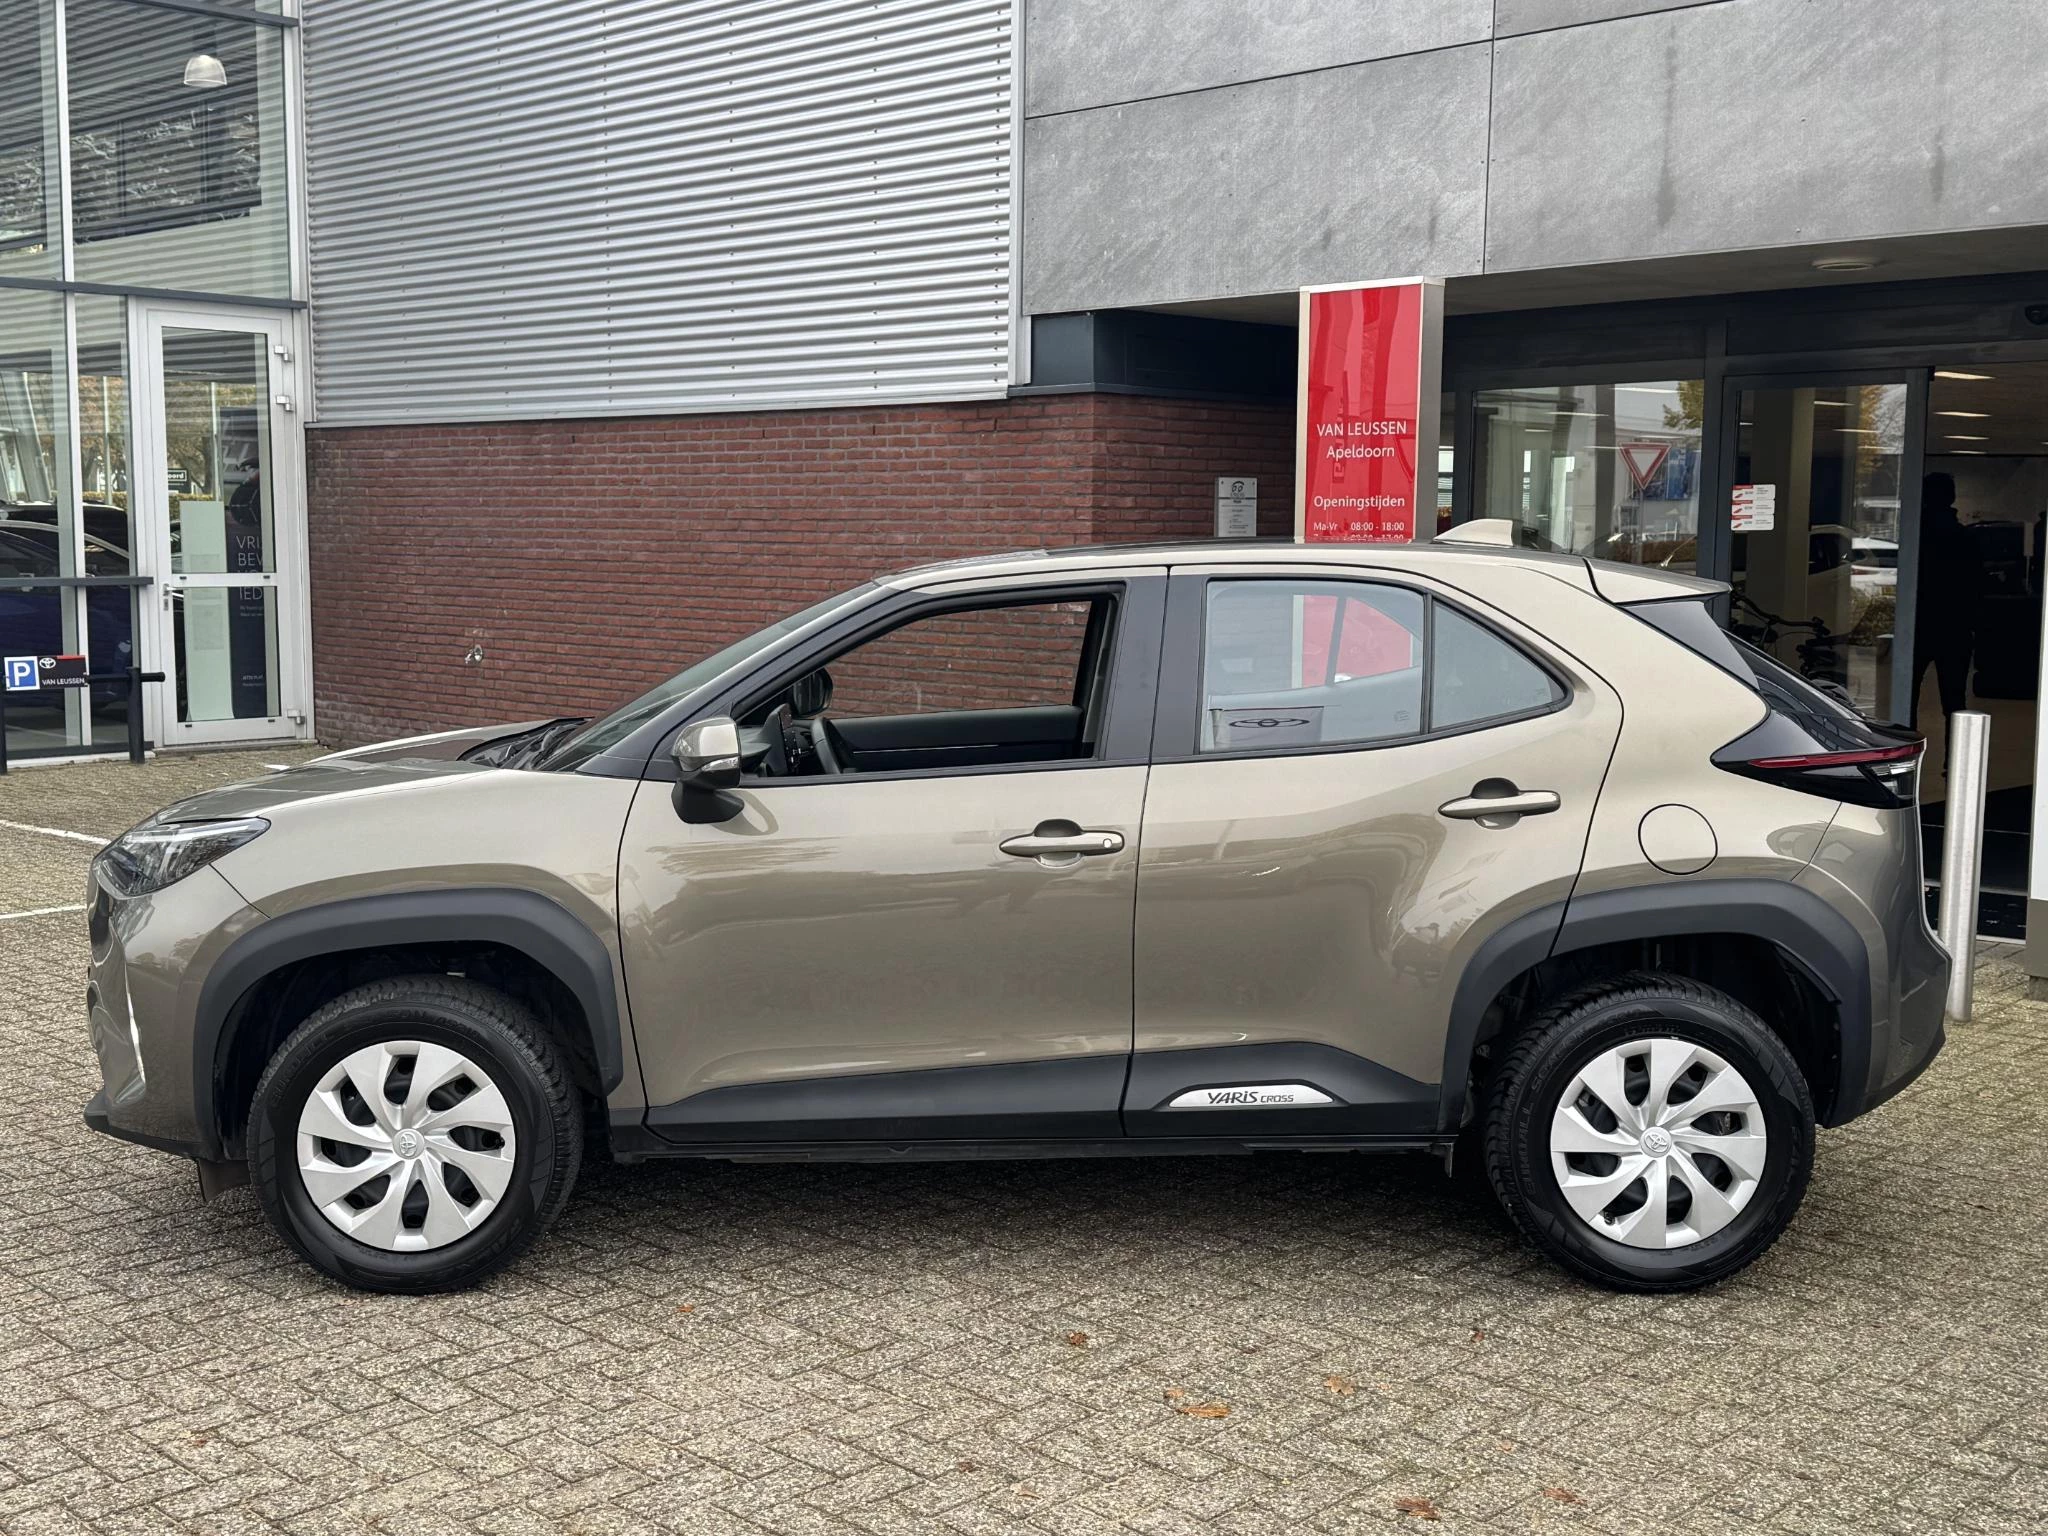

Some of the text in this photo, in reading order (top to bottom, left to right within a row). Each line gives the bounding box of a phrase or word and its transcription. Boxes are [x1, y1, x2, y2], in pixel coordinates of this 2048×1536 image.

[1316, 420, 1407, 437] VAN LEUSSEN
[1326, 443, 1395, 461] Apeldoorn
[1313, 495, 1405, 511] Openingstijden
[1350, 521, 1374, 531] 08:00
[1382, 521, 1405, 531] 18:00
[13, 662, 31, 686] P
[42, 677, 85, 686] VAN LEUSSEN
[1260, 1094, 1294, 1103] CROSS
